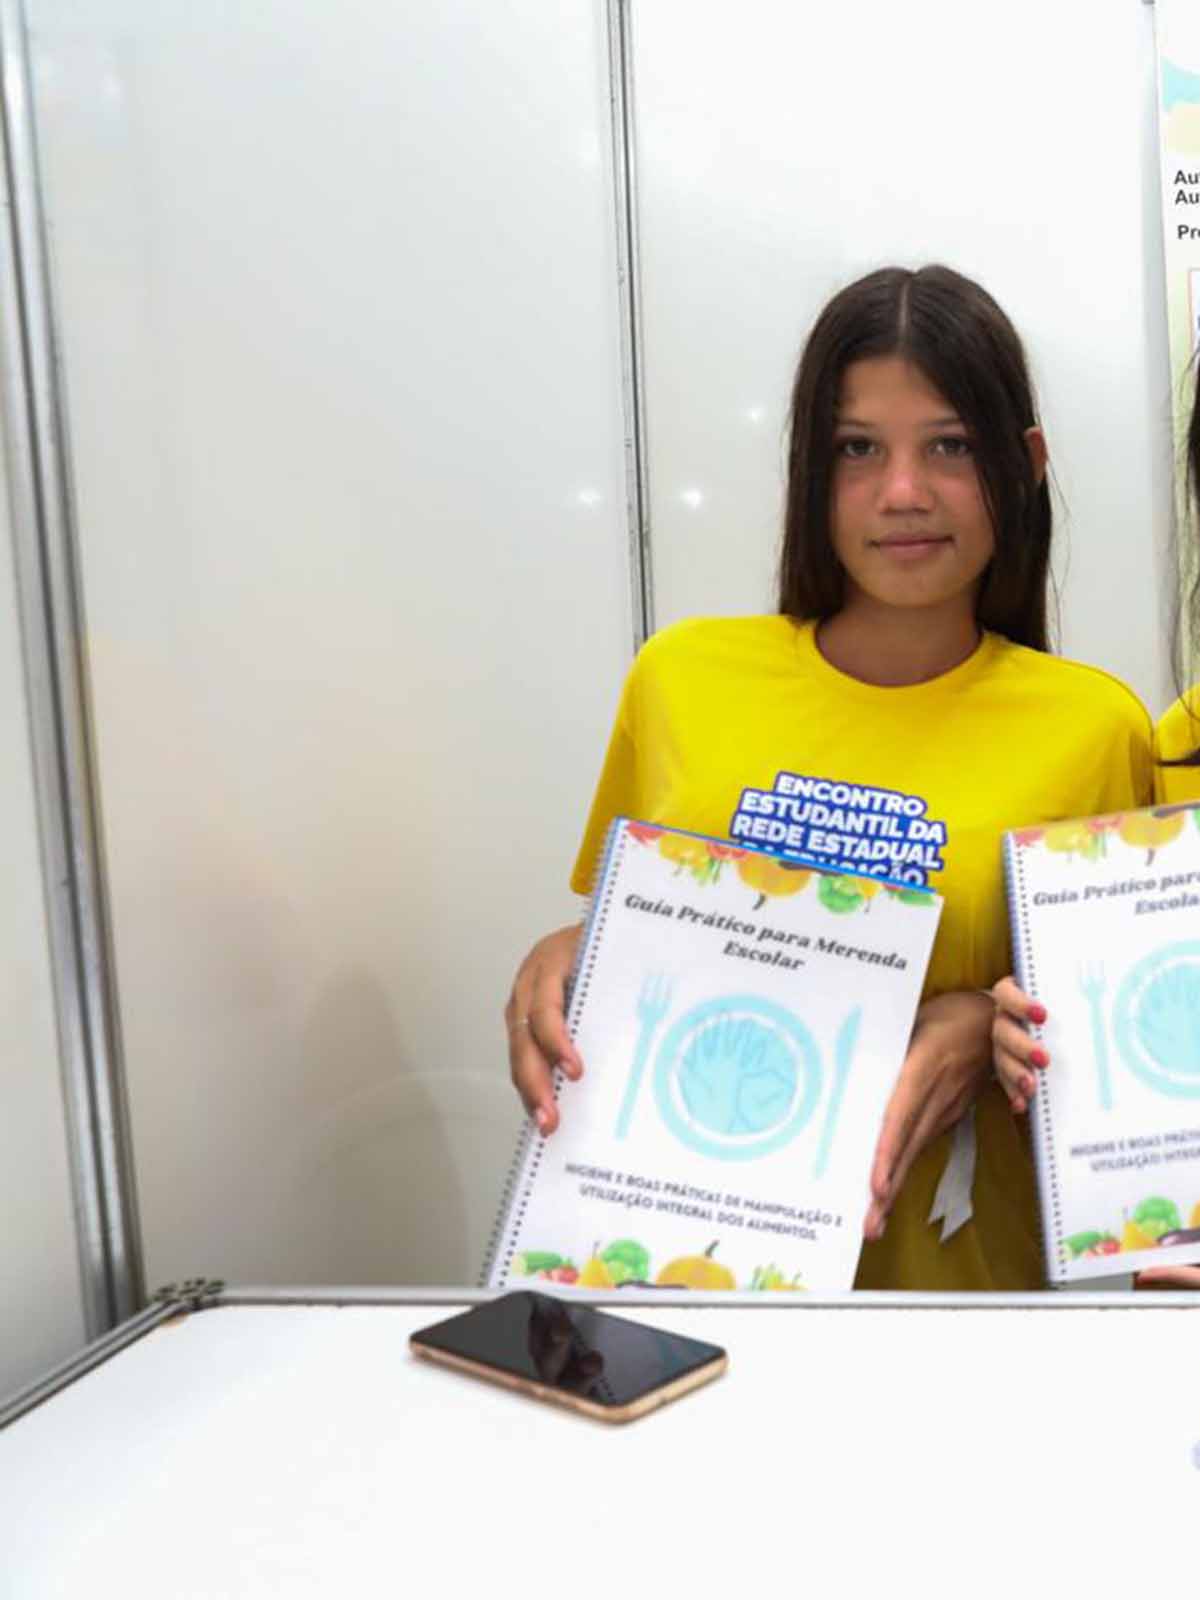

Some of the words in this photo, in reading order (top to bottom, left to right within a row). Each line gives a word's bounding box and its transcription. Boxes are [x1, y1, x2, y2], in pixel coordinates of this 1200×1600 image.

[776, 774, 924, 816] ENCONTRO
[741, 791, 904, 838] ESTUDANTIL
[907, 820, 945, 843] DA
[733, 813, 804, 845] REDE
[807, 831, 942, 869] ESTADUAL
[1033, 889, 1078, 908] Guia
[1083, 877, 1157, 901] Prático
[624, 893, 674, 918] Guia
[677, 904, 755, 936] Prático
[758, 925, 811, 949] para
[813, 937, 908, 971] Merenda
[723, 940, 806, 971] Escolar
[626, 1174, 661, 1193] BOAS
[717, 1212, 744, 1228] DOS
